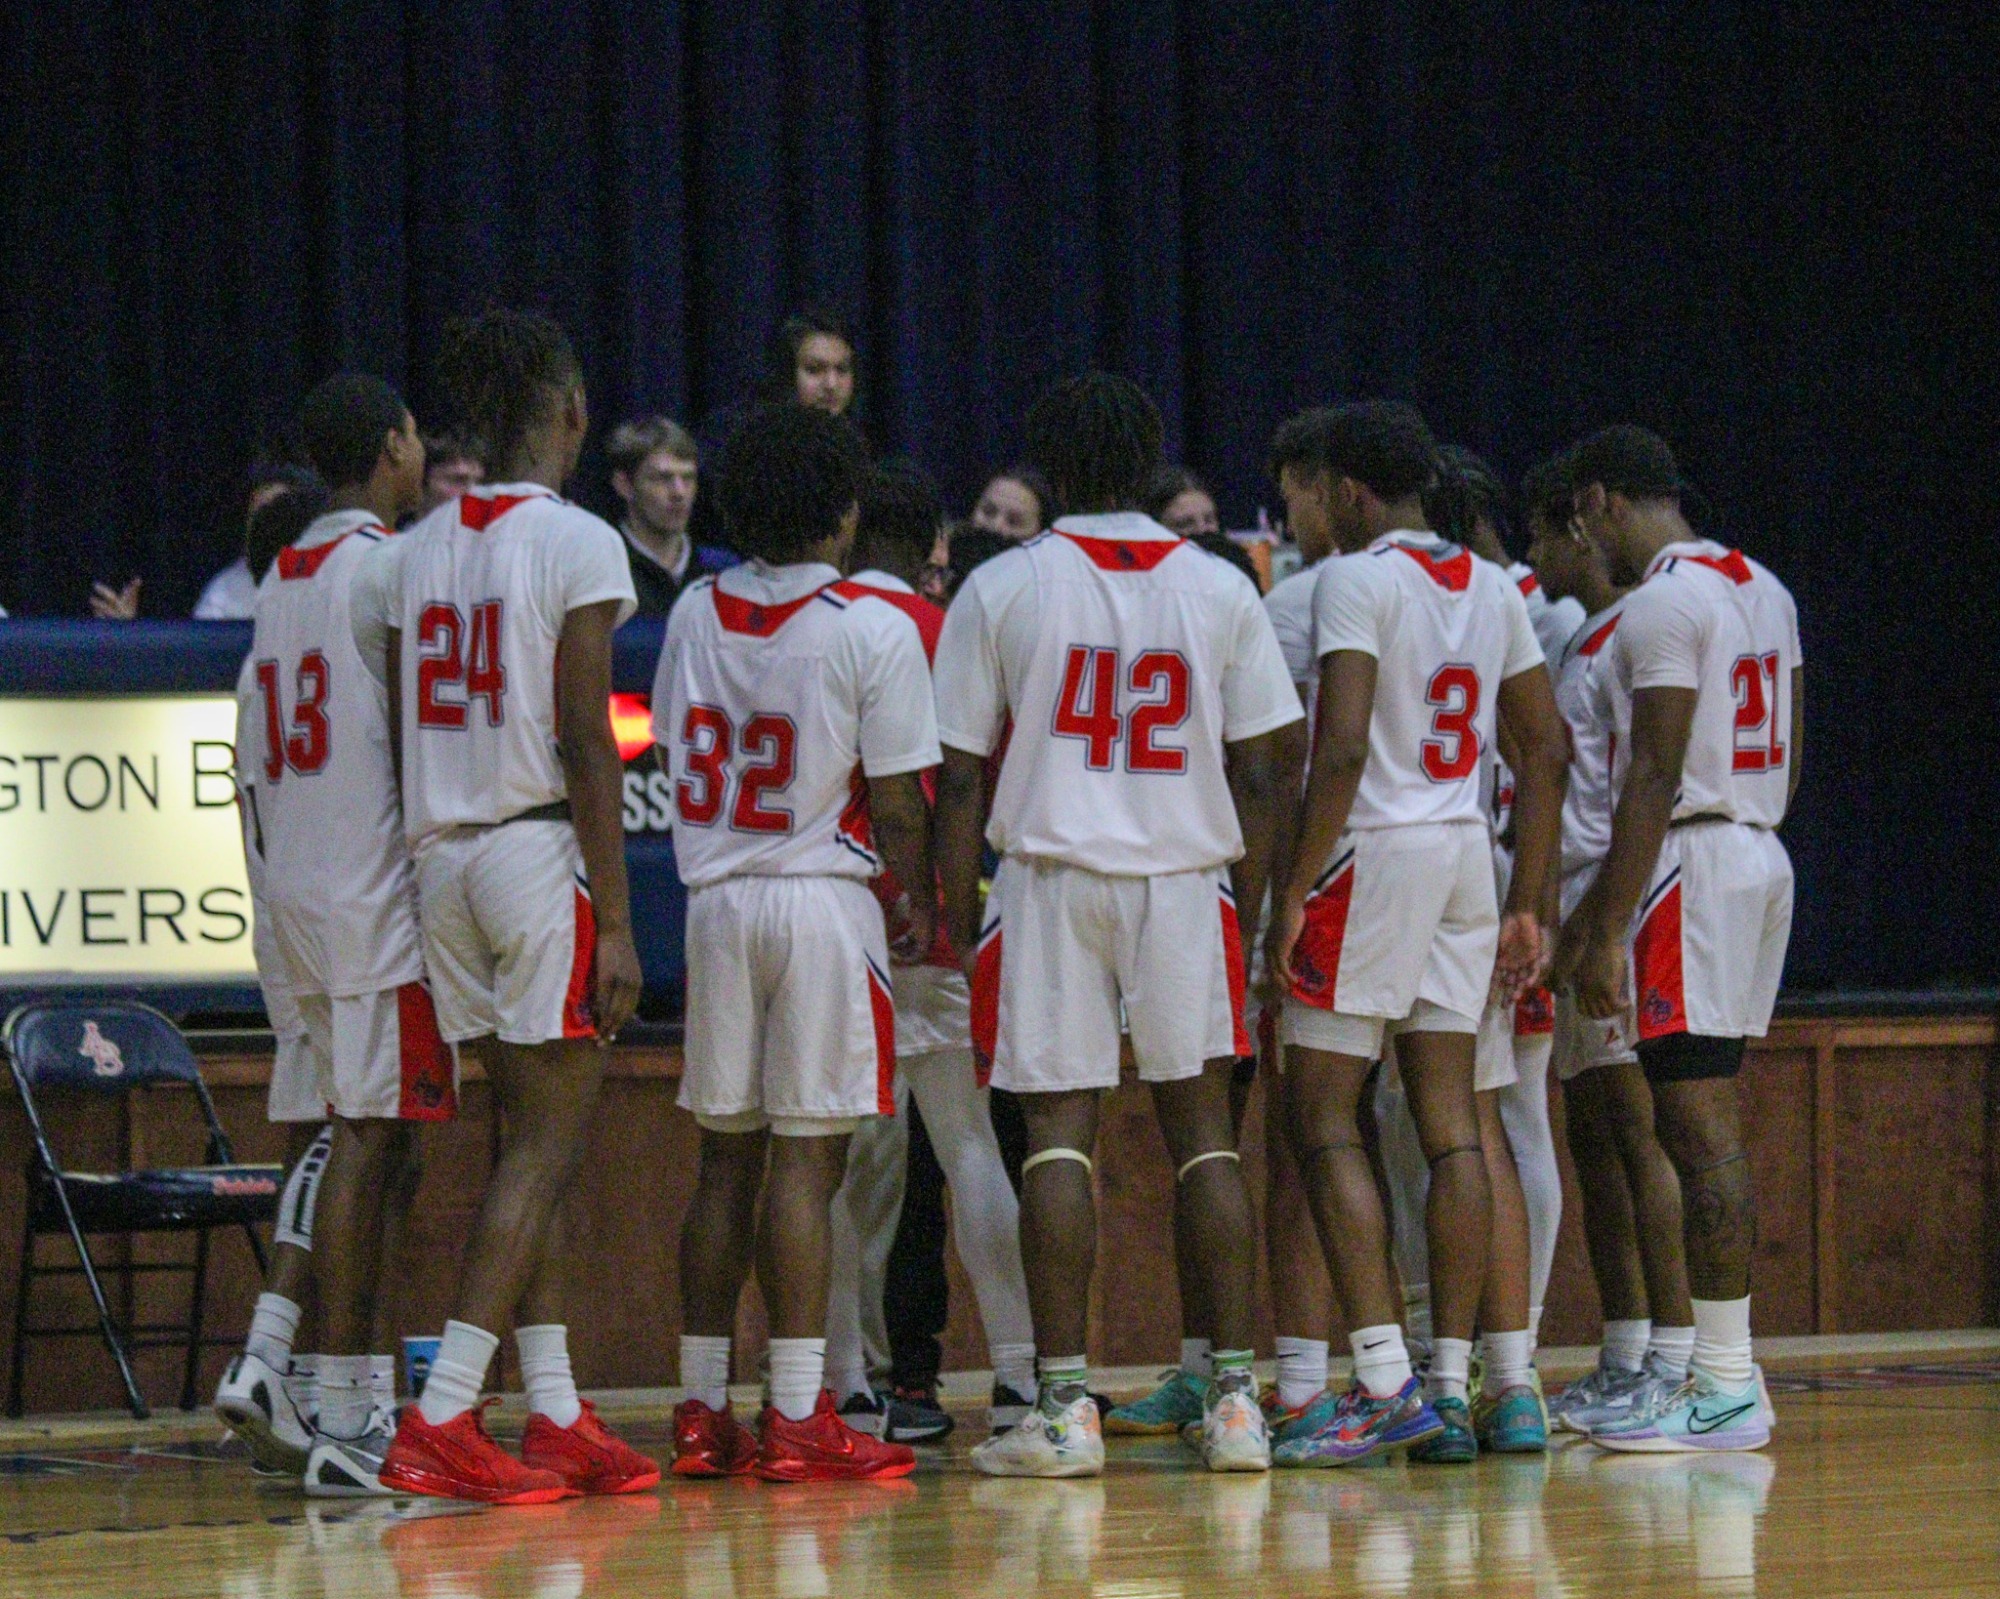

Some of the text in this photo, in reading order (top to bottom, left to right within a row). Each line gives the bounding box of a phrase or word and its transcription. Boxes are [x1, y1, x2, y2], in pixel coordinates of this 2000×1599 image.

[256, 647, 331, 785] 13
[417, 597, 507, 731] 24
[1051, 643, 1192, 775] 42
[1420, 663, 1482, 783] 3
[1729, 650, 1785, 775] 21
[676, 702, 798, 835] 32
